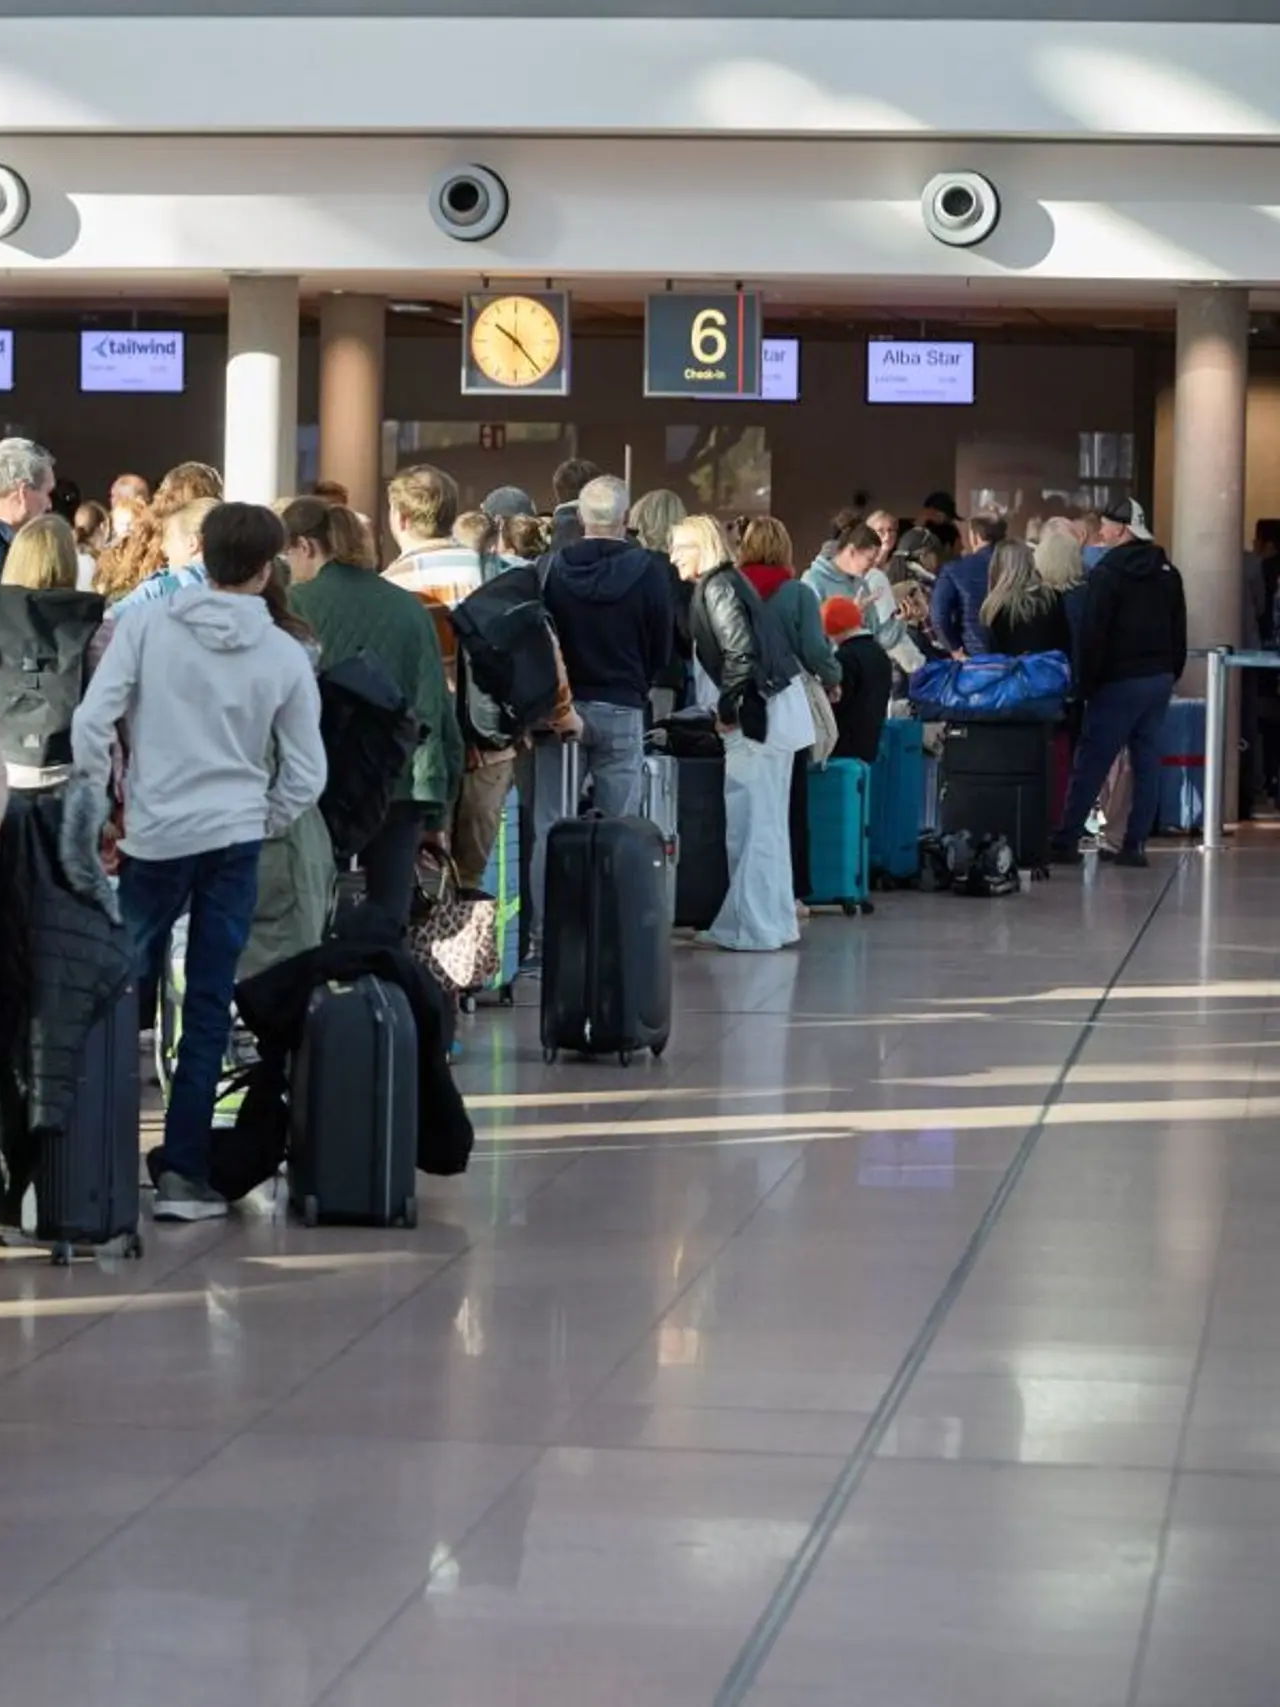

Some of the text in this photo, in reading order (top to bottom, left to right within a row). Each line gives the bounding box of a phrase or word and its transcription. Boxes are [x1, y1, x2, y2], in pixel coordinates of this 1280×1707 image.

[691, 308, 727, 364] 6
[109, 337, 176, 355] tailwind
[764, 349, 786, 362] tar
[882, 349, 961, 366] Alba Star
